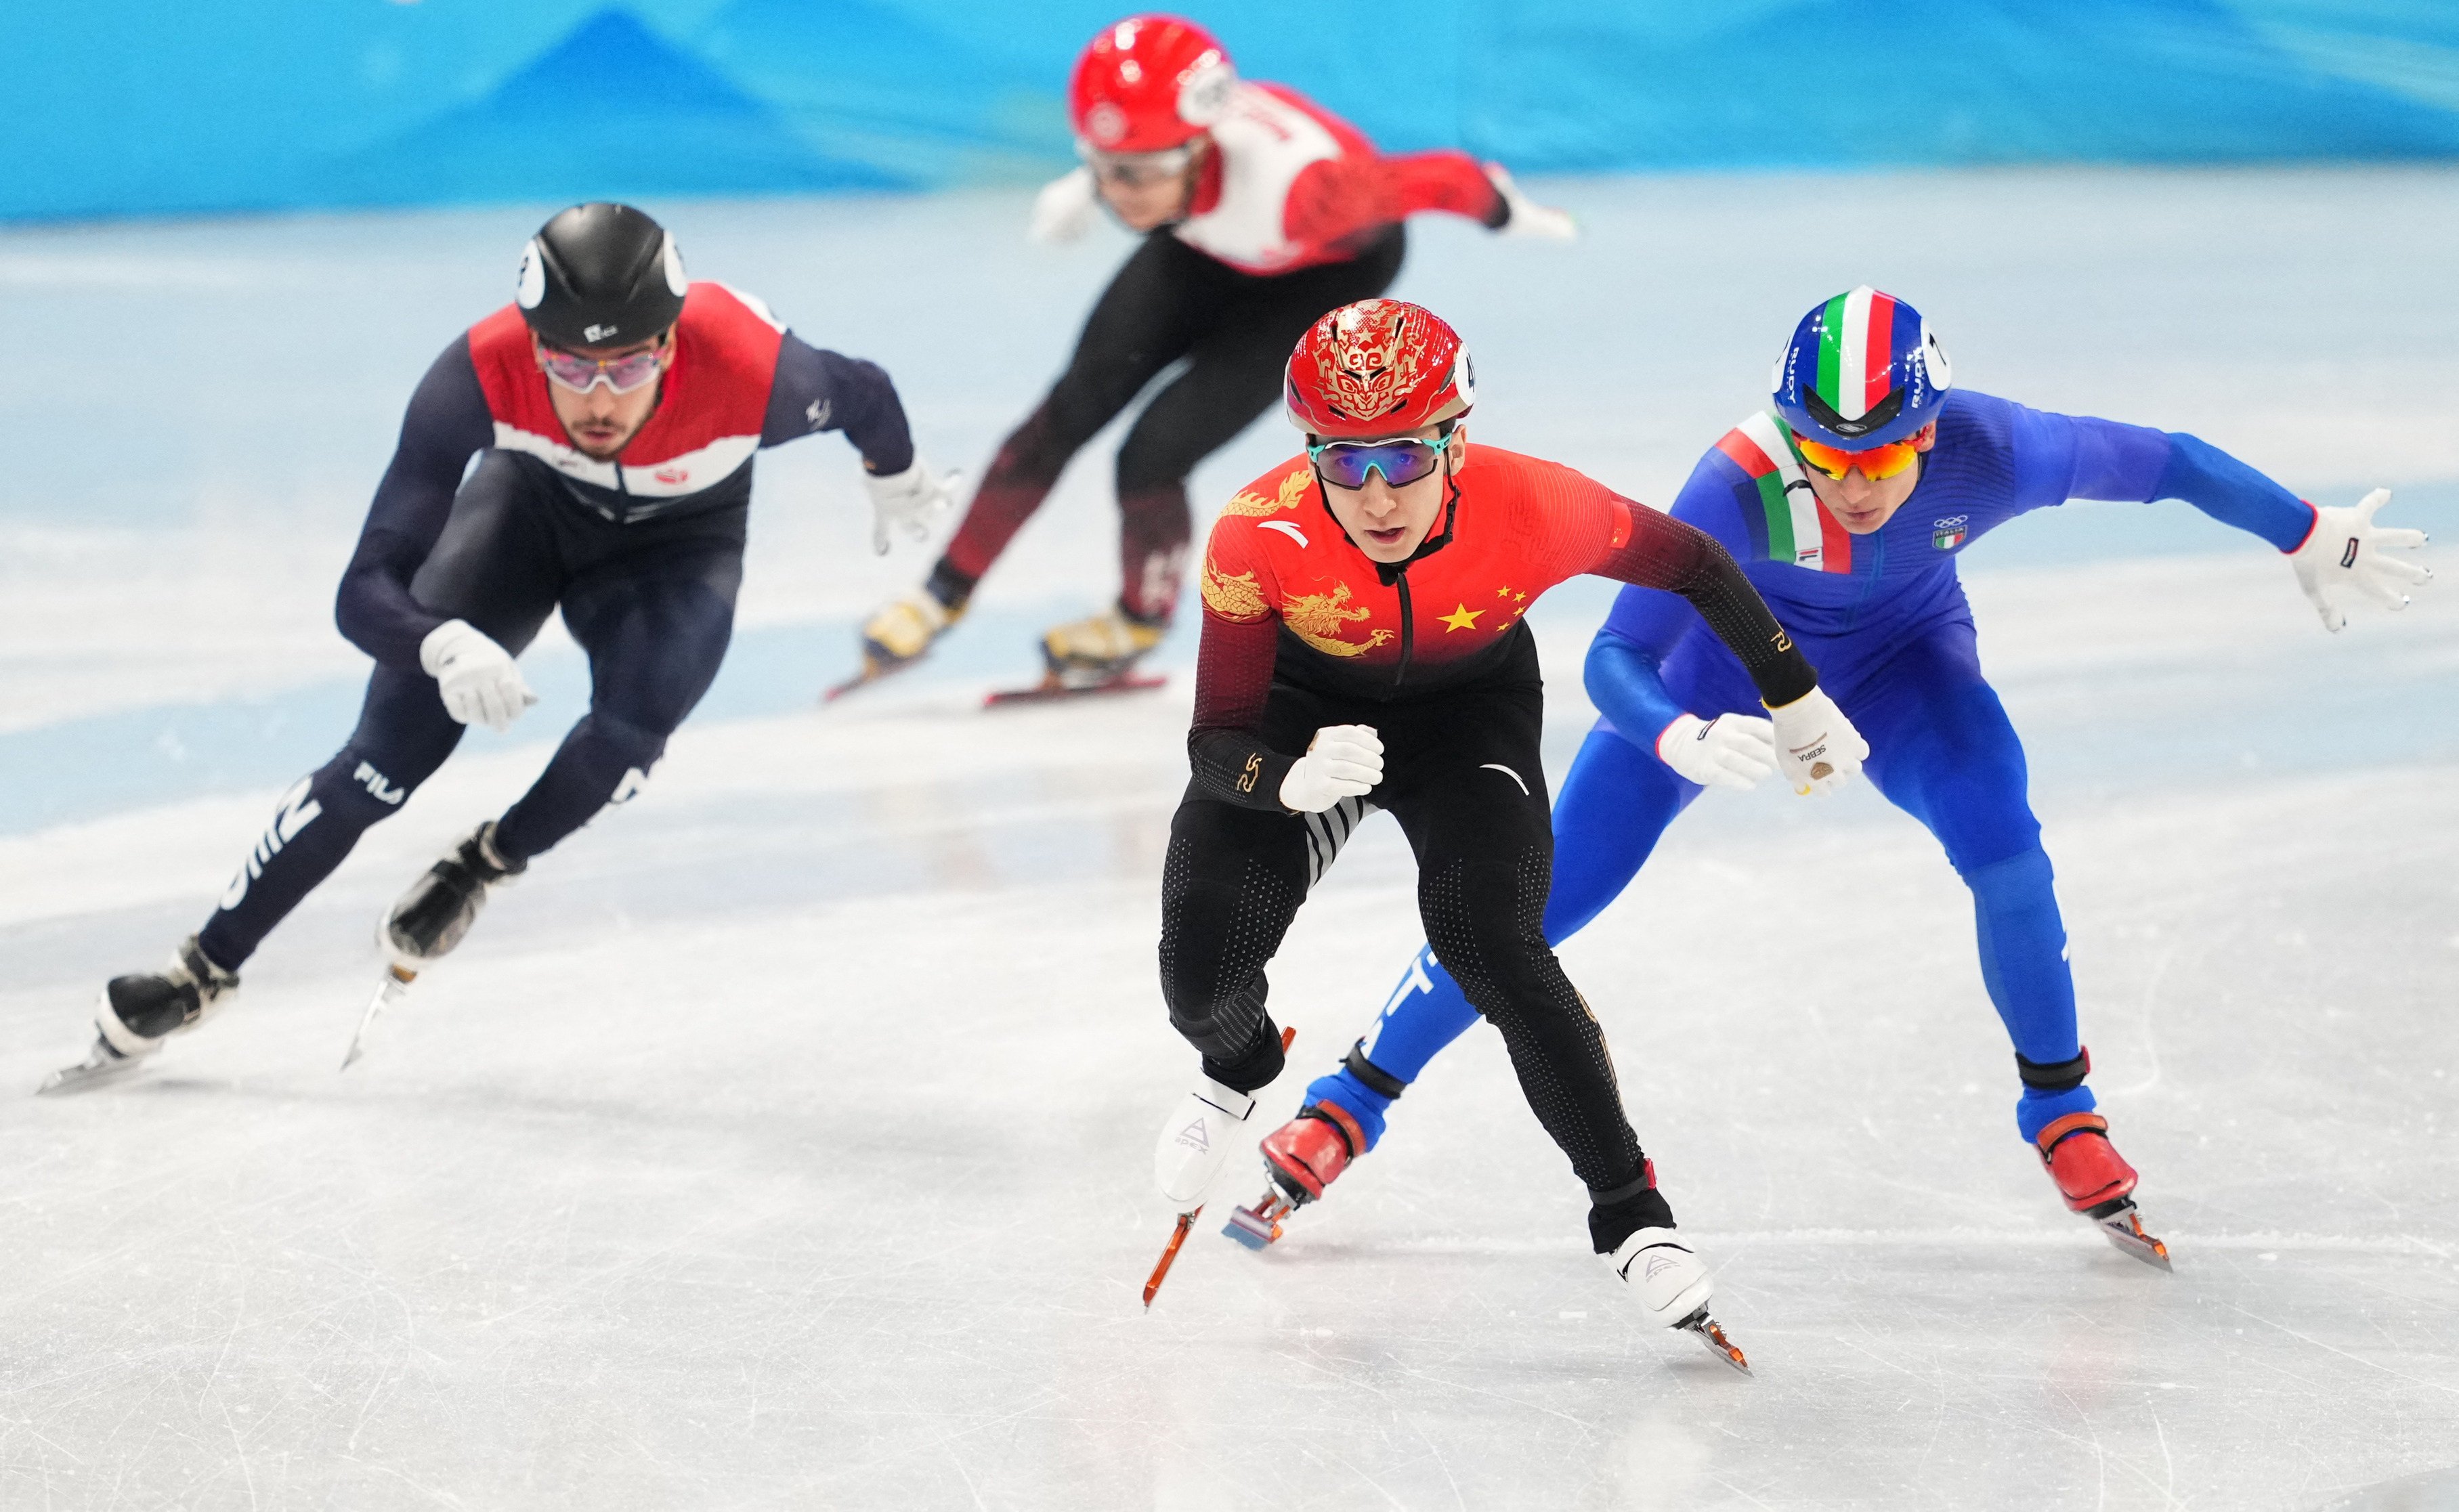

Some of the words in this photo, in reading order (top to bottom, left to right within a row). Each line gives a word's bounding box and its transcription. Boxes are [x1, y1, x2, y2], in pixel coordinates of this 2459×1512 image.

[1789, 346, 1800, 404] RUDY
[1797, 745, 1826, 762] SEBRA
[353, 760, 405, 804] FILA
